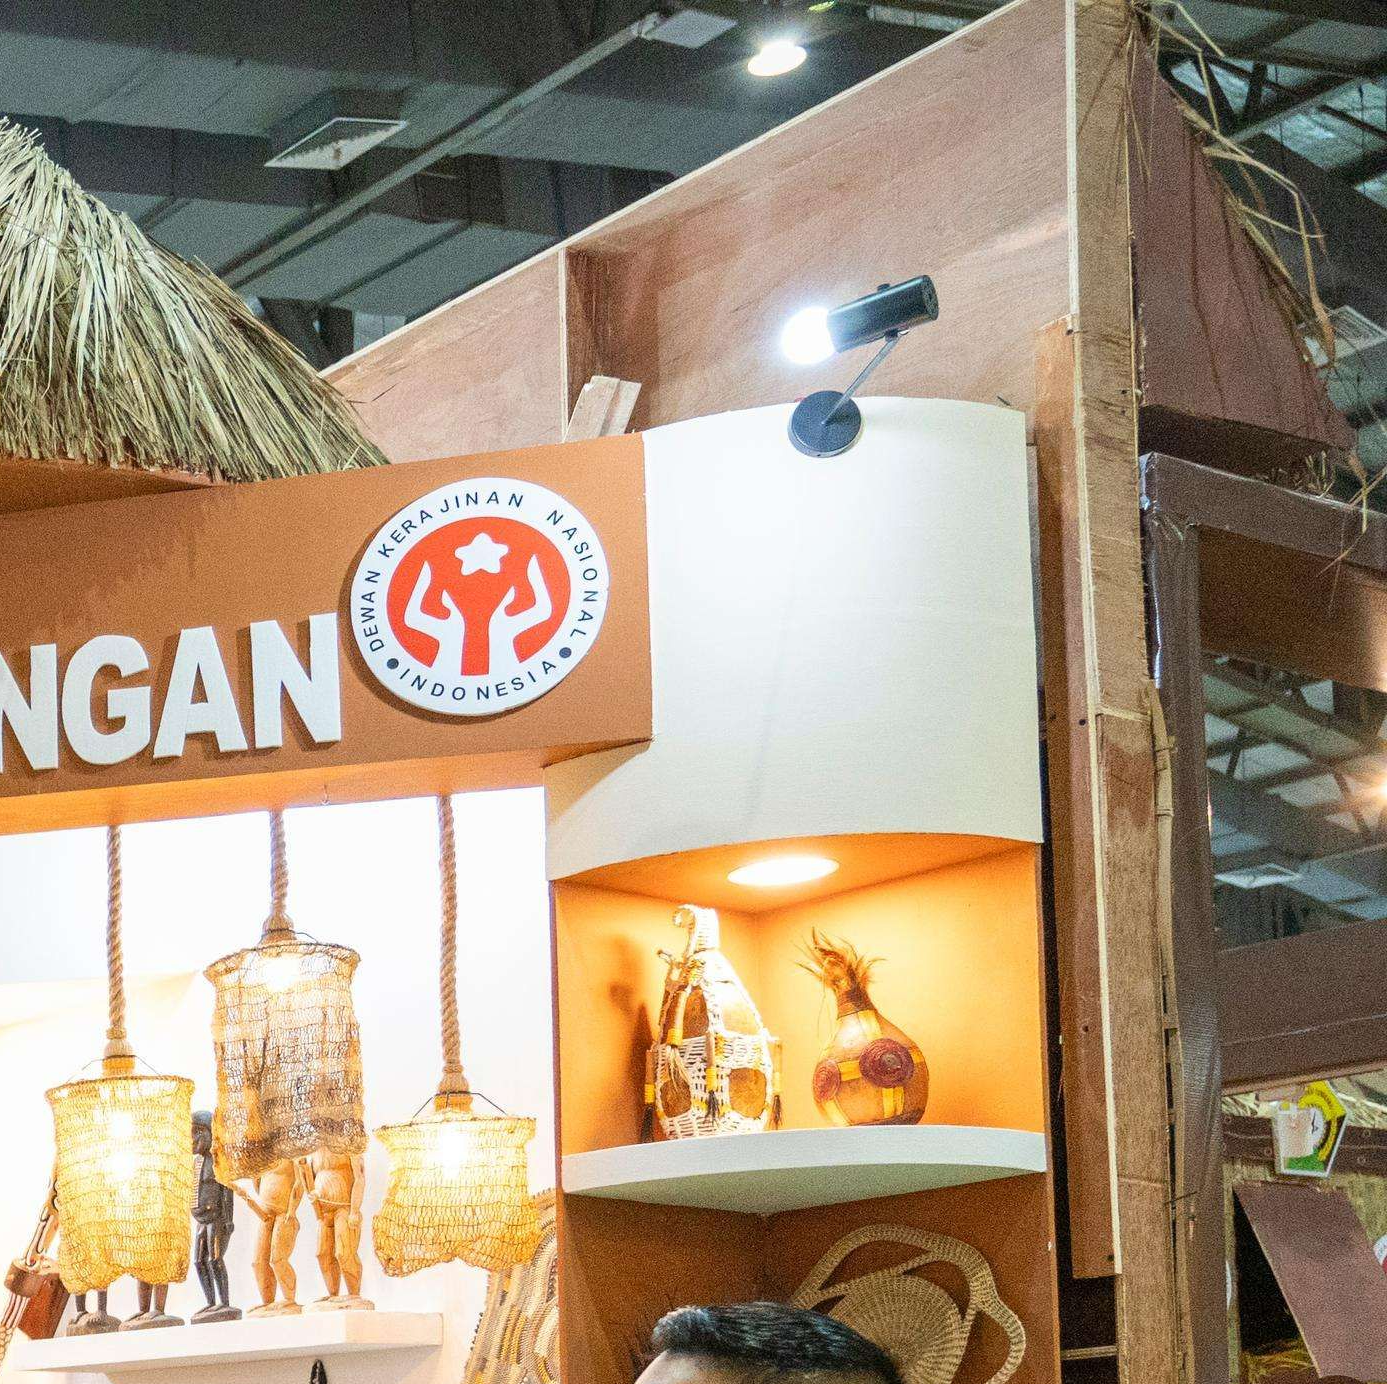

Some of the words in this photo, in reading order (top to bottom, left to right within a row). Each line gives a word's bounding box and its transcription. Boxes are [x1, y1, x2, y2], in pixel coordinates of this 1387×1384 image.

[360, 570, 385, 652] DEWAN
[378, 491, 524, 558] KERAJINAN
[546, 509, 599, 639] NASIONAL
[399, 660, 557, 702] INDONESIA
